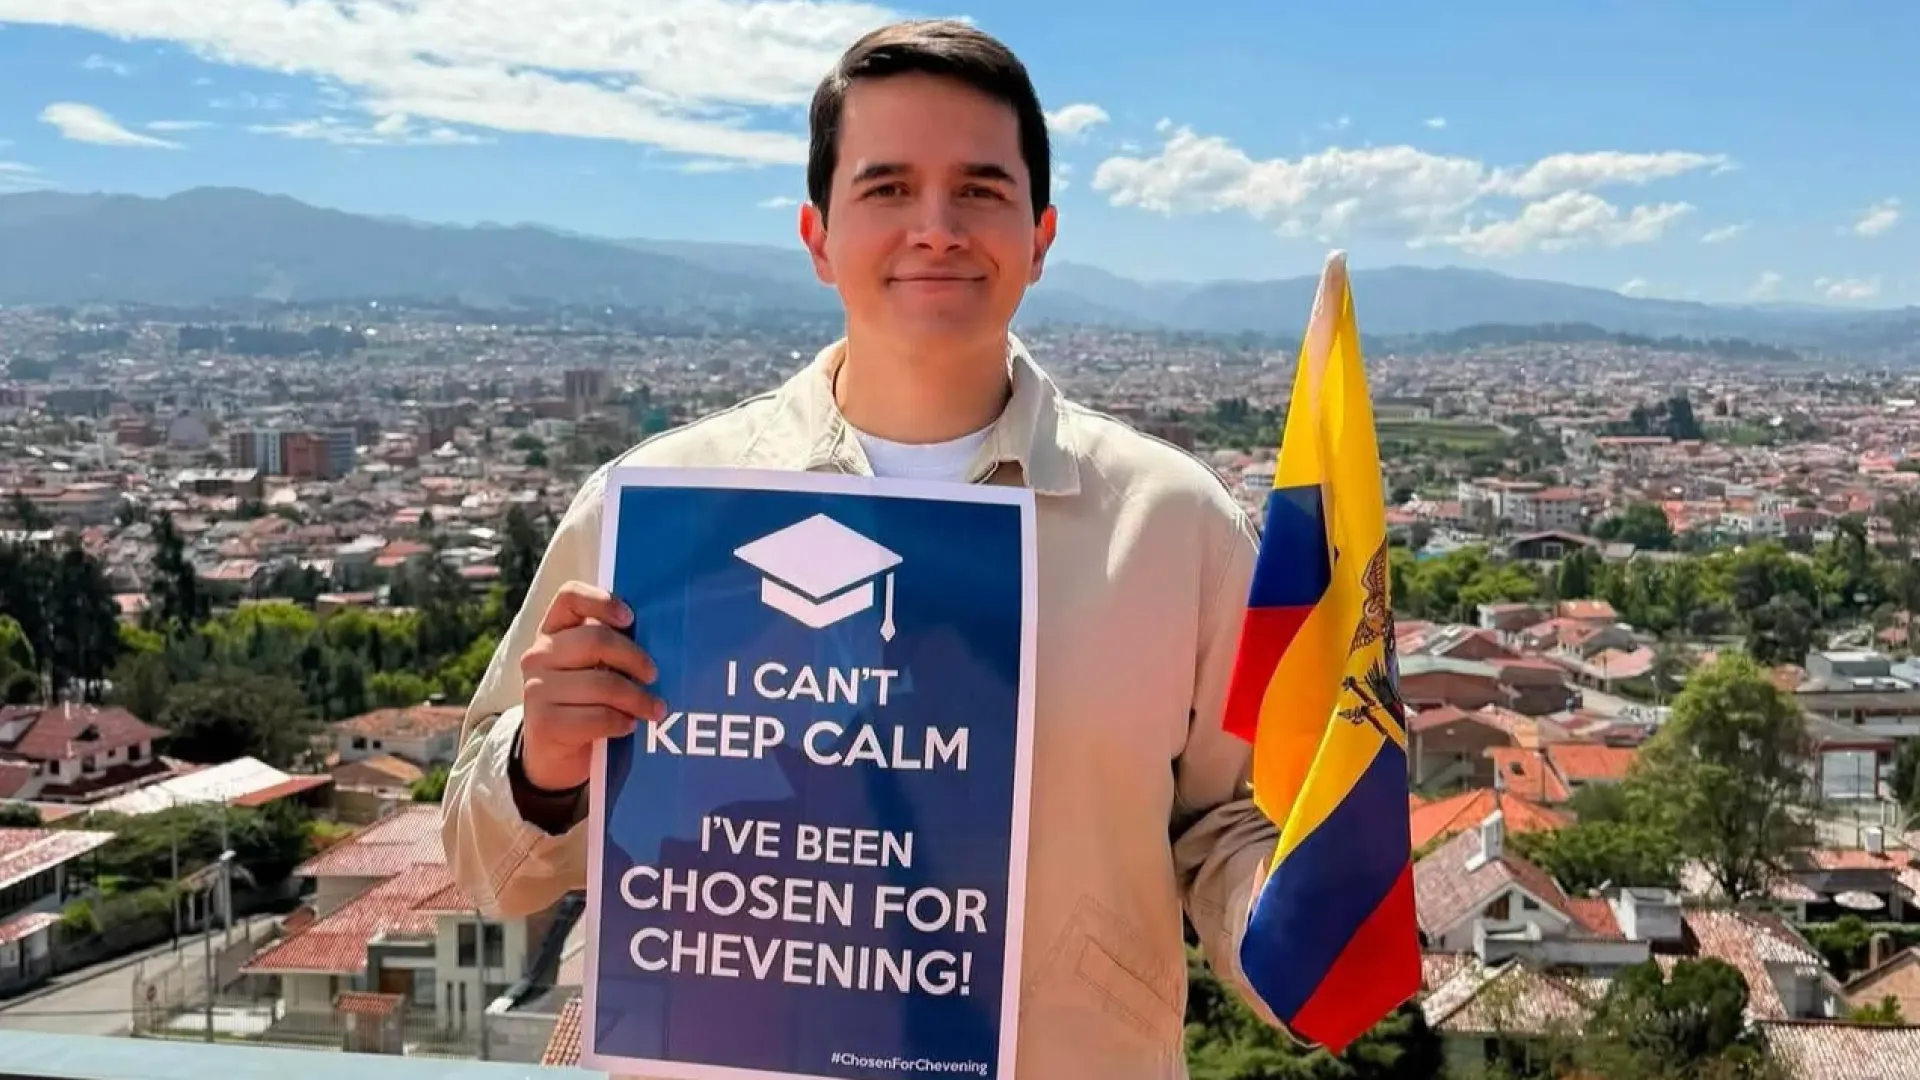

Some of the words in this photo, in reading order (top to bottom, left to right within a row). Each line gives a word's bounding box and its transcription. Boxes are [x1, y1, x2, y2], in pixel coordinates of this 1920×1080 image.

[726, 660, 738, 697] I
[753, 661, 899, 706] CAN'T
[645, 712, 786, 760] KEEP
[803, 720, 970, 771] CALM
[701, 816, 781, 859] I'VE
[796, 824, 914, 868] BEEN
[619, 865, 854, 927] CHOSEN
[874, 886, 988, 934] FOR
[629, 927, 974, 996] CHEVENING!
[831, 1052, 988, 1076] #ChosenForChevening
